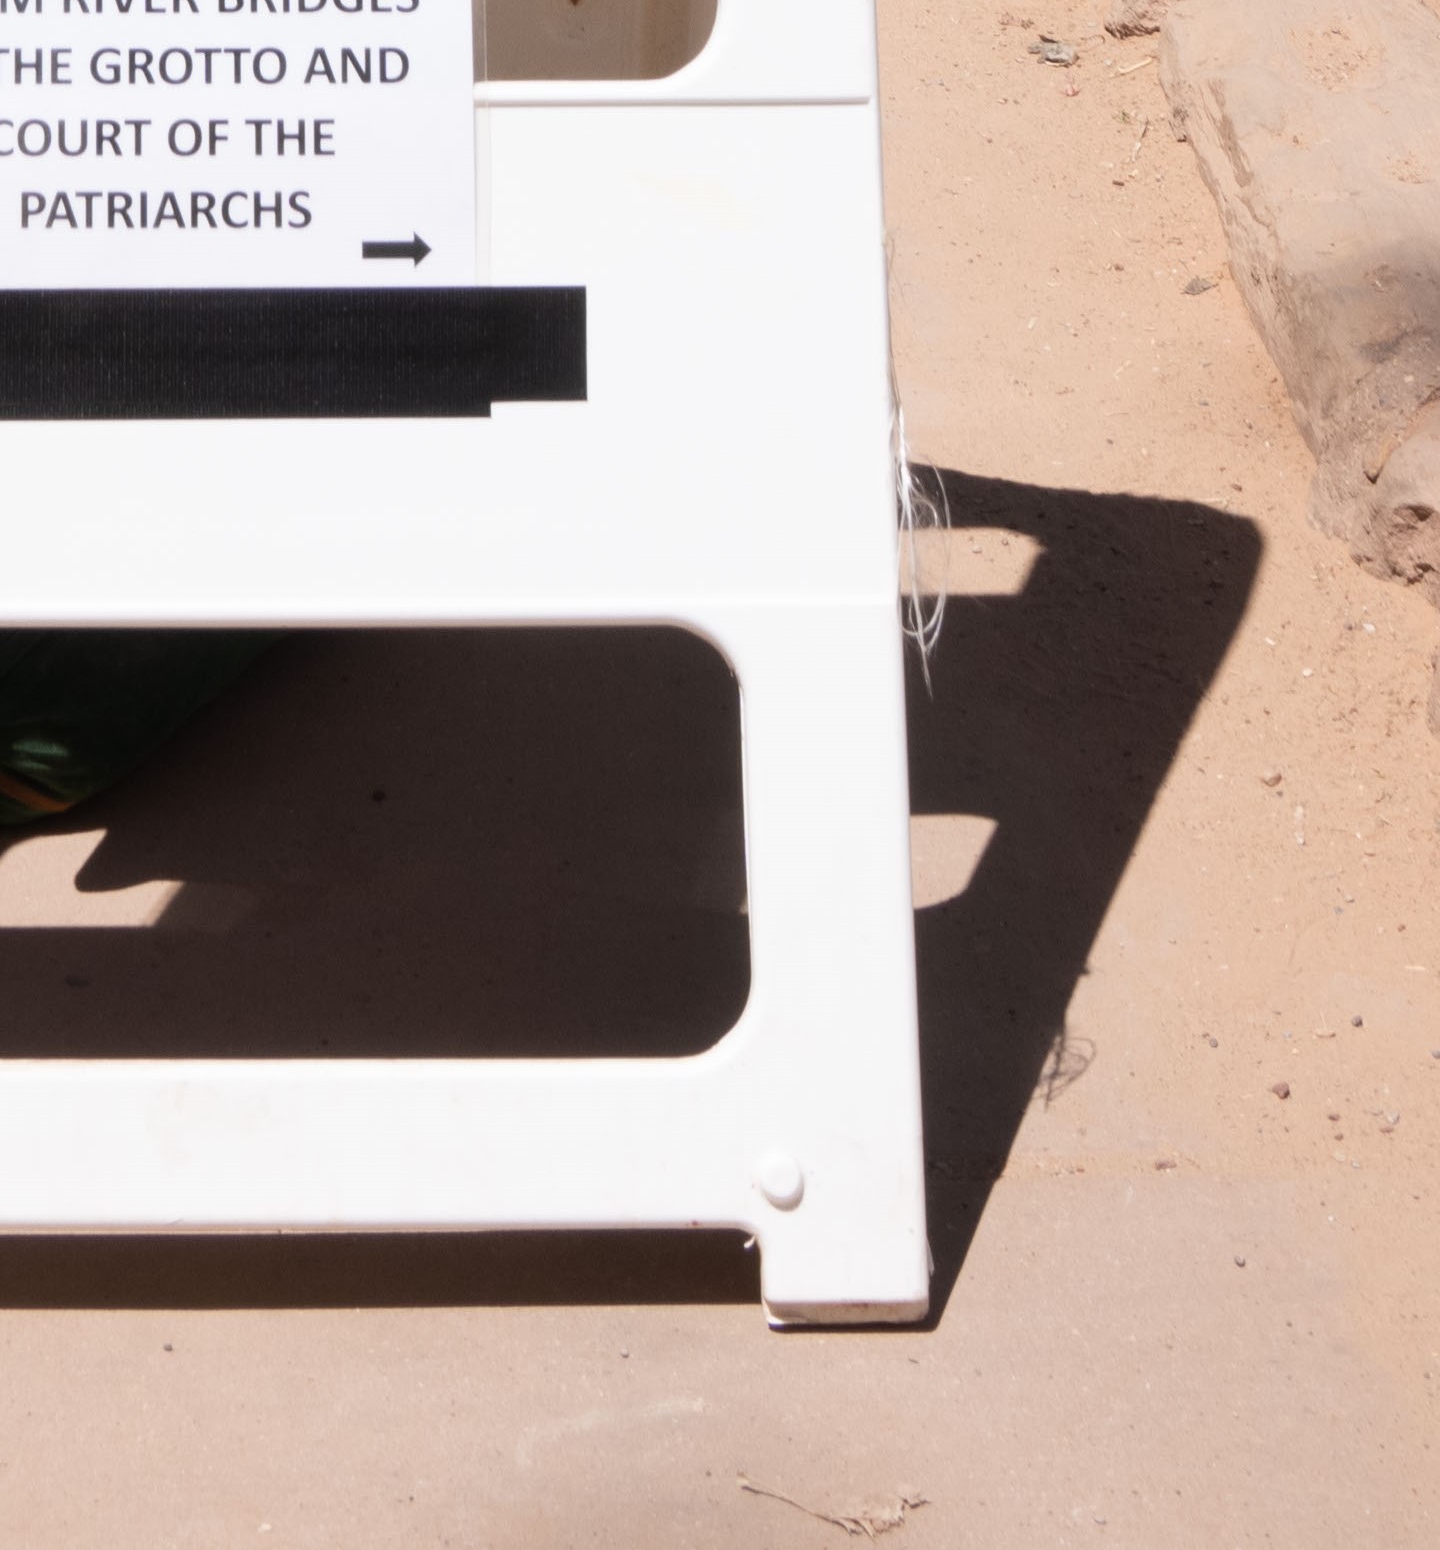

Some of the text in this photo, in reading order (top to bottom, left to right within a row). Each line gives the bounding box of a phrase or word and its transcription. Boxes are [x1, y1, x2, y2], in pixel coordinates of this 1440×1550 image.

[90, 47, 287, 85] GROTTO
[304, 47, 410, 84] AND
[167, 119, 229, 157] OF
[245, 119, 335, 156] THE
[21, 191, 312, 229] PATRIARCHS
